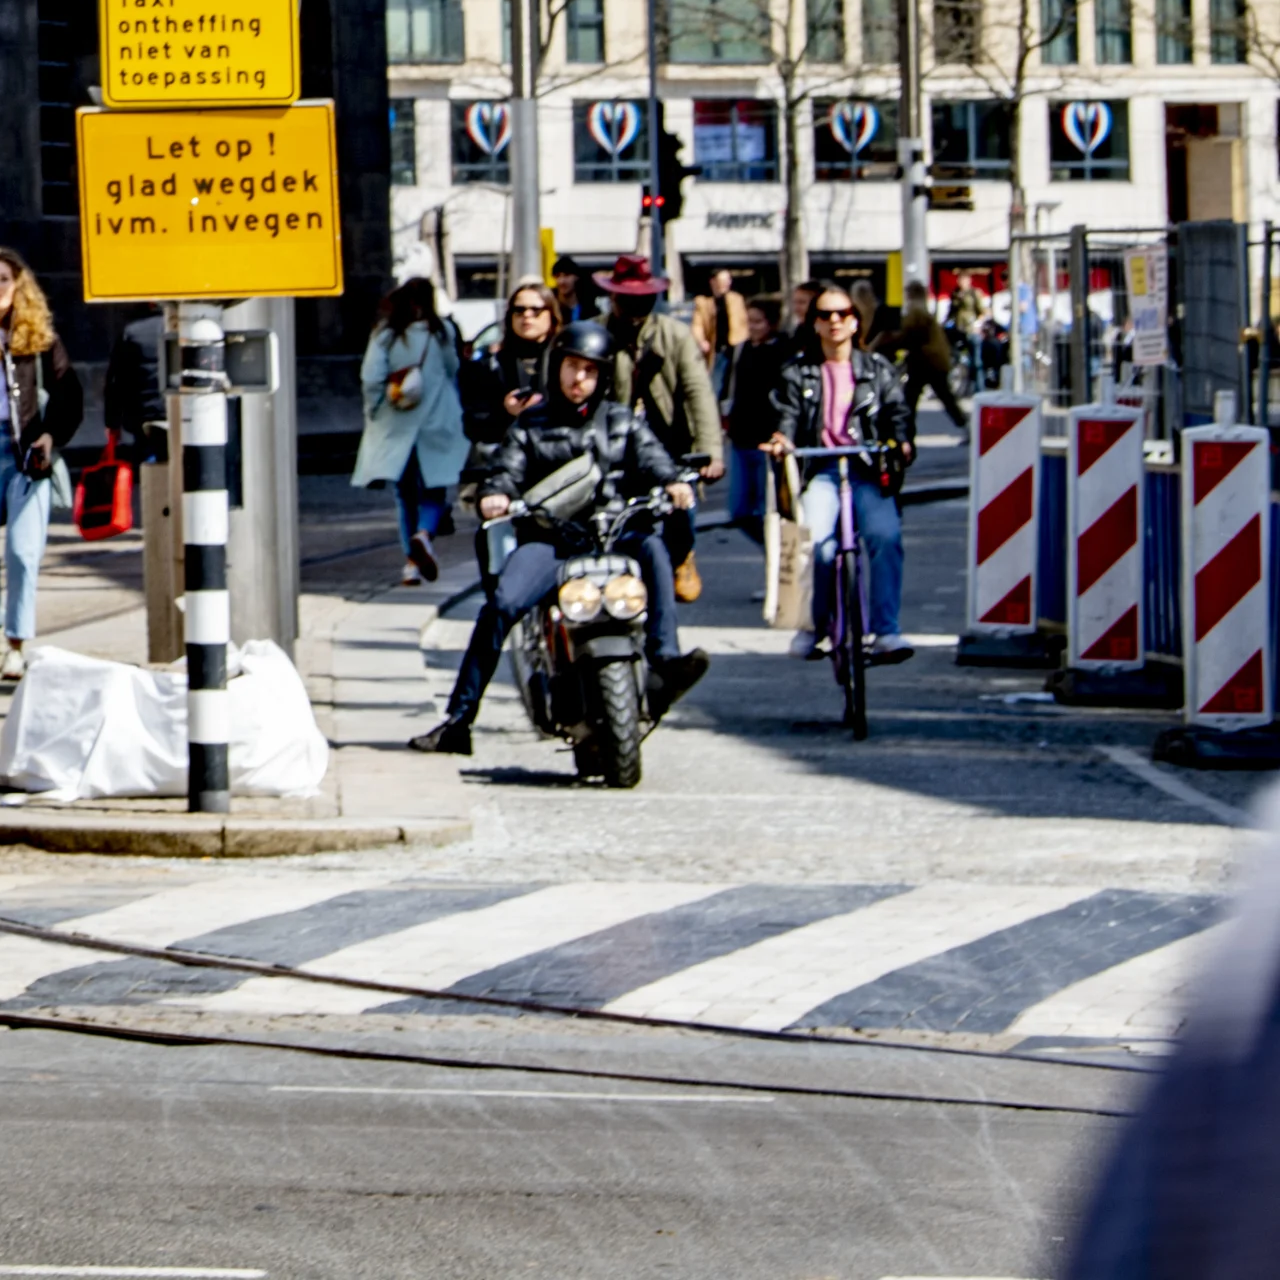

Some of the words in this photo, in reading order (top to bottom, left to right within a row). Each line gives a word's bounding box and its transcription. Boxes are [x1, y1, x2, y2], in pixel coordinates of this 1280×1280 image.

[117, 14, 262, 38] ontheffing
[119, 41, 172, 61] niet
[184, 42, 231, 59] van
[119, 66, 266, 89] toepassing
[146, 135, 201, 161] Let
[106, 173, 178, 204] glad
[192, 169, 320, 202] wegdek
[187, 209, 324, 238] invegen
